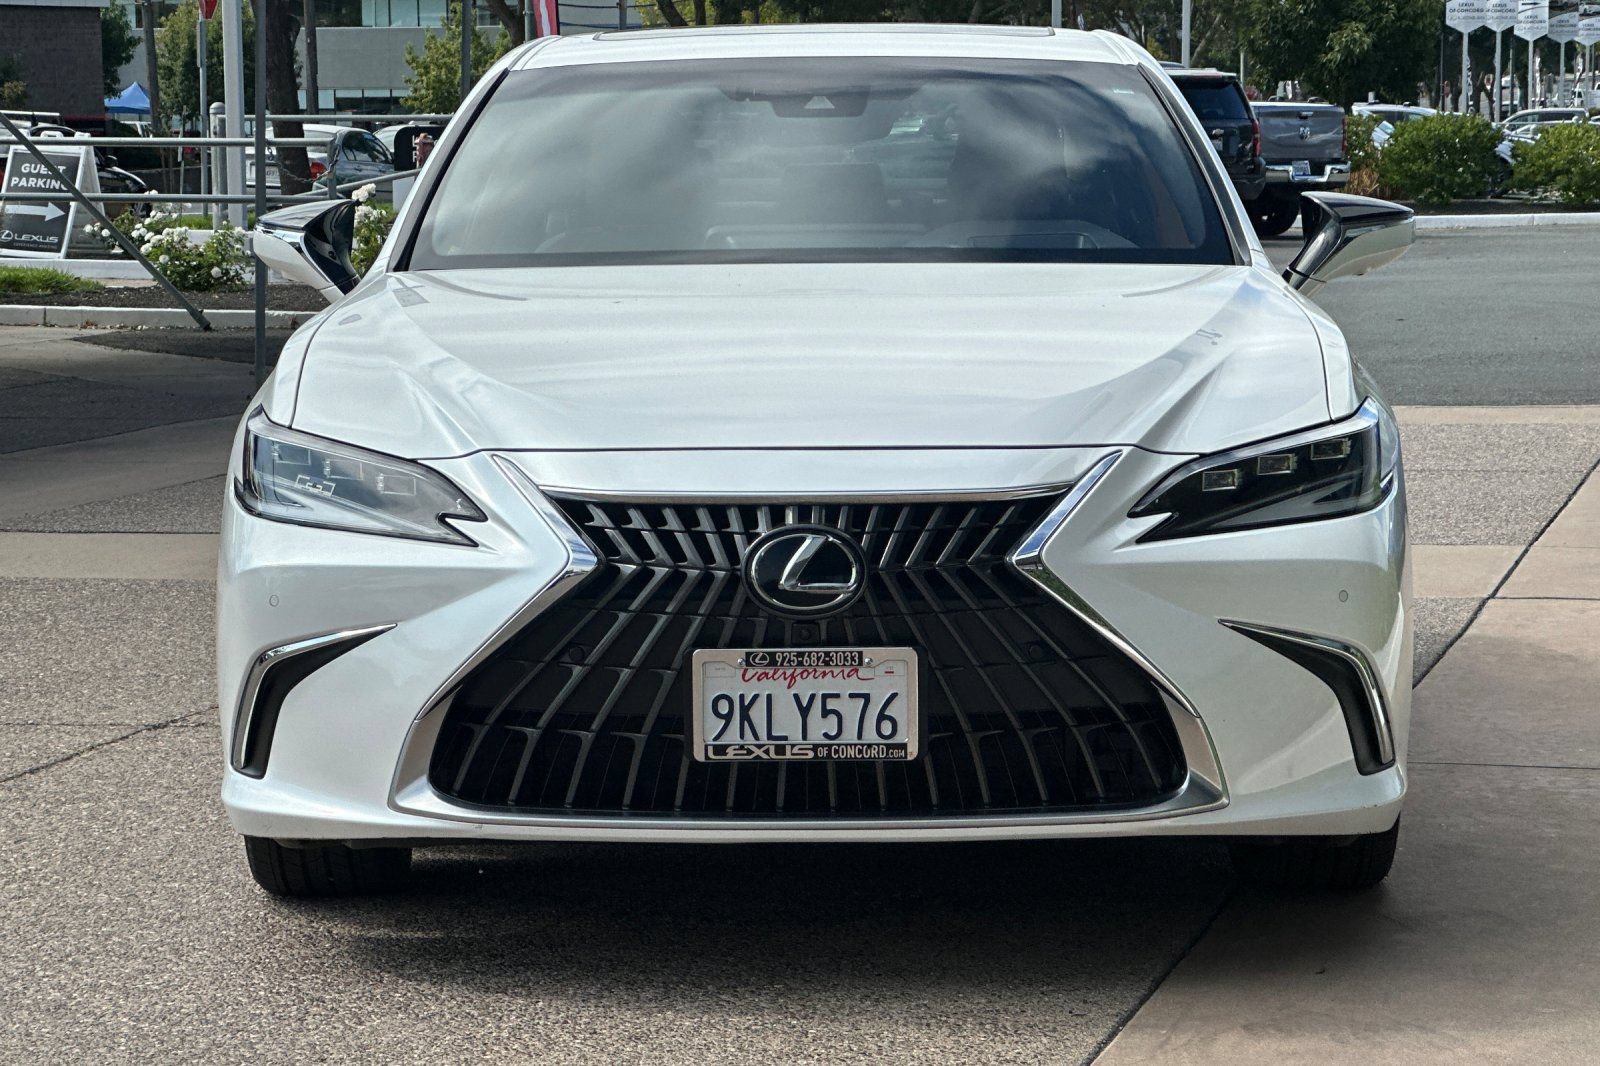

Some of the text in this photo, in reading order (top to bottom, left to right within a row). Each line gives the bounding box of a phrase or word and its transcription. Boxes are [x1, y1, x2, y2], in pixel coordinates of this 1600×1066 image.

[21, 163, 67, 175] GUET
[10, 177, 69, 190] PARKIN
[14, 233, 59, 243] LEXUS
[775, 652, 859, 667] 925-682-3033
[741, 667, 875, 689] California
[711, 692, 899, 742] 9KLY576
[707, 744, 815, 760] LEXUS
[817, 748, 829, 758] OF
